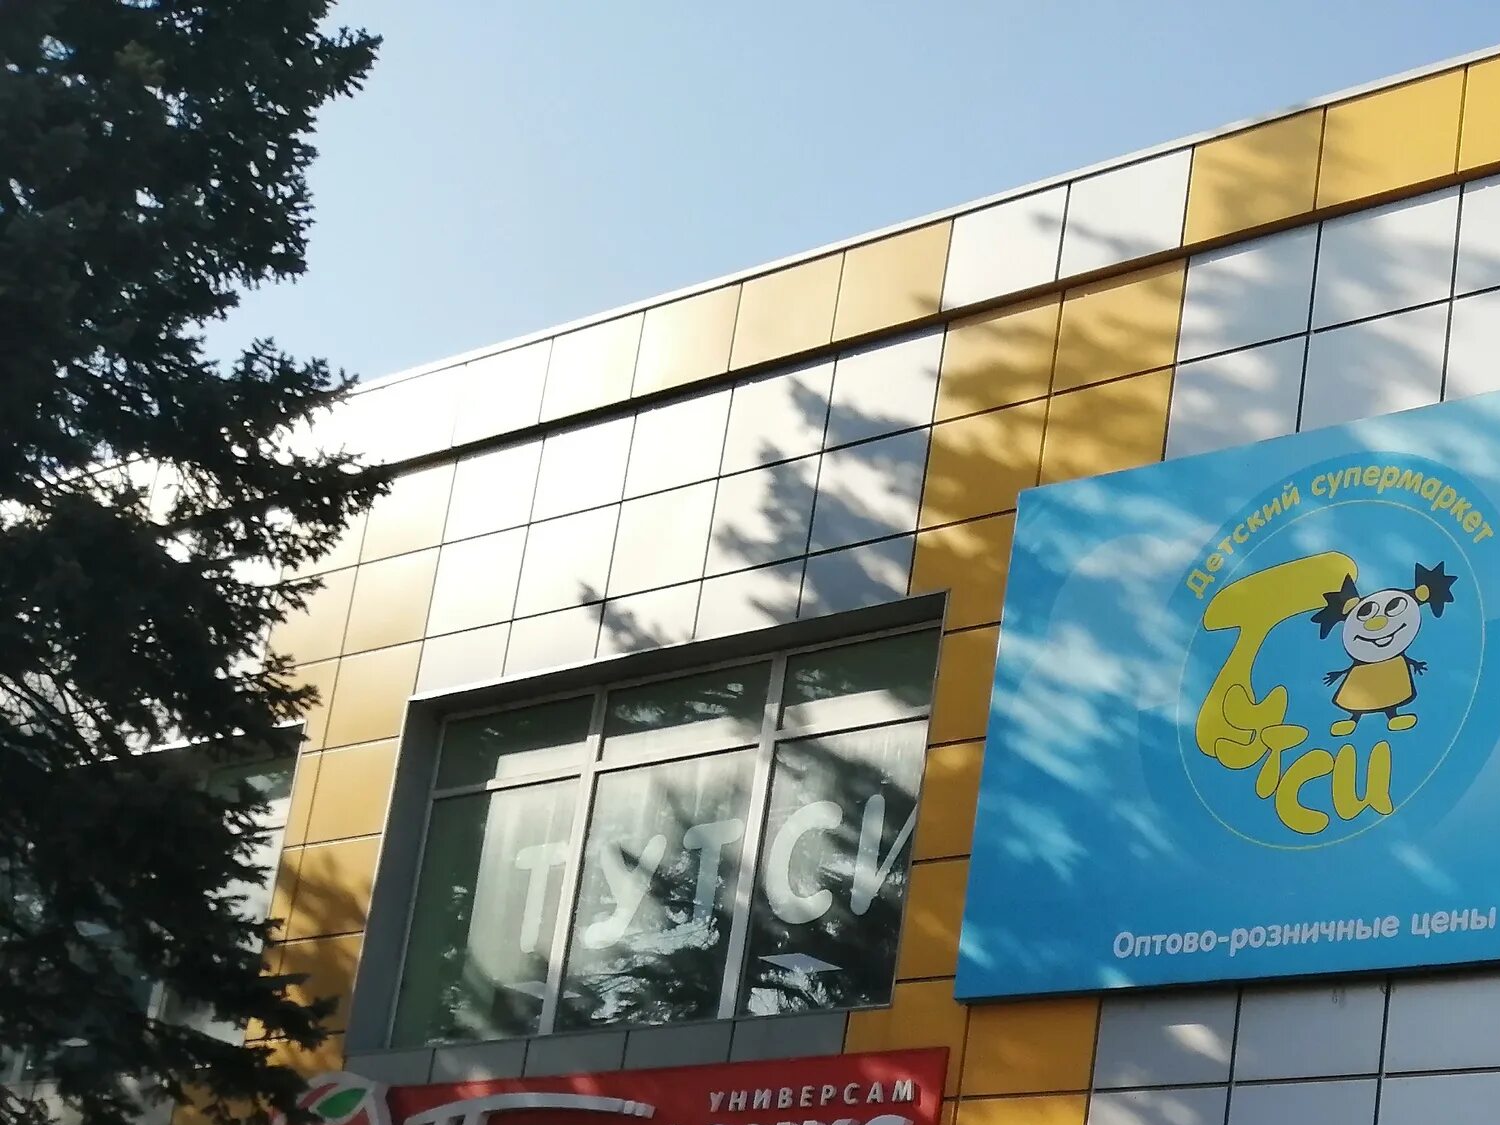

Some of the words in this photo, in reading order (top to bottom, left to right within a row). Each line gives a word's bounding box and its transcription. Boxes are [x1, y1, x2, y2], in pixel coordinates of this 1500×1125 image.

[1186, 483, 1301, 600] Детский
[1311, 465, 1496, 544] супермаркет
[1113, 914, 1400, 959] Оптово-розничные
[1411, 907, 1498, 939] цены
[709, 1079, 915, 1113] УНИВЕРСАМ
